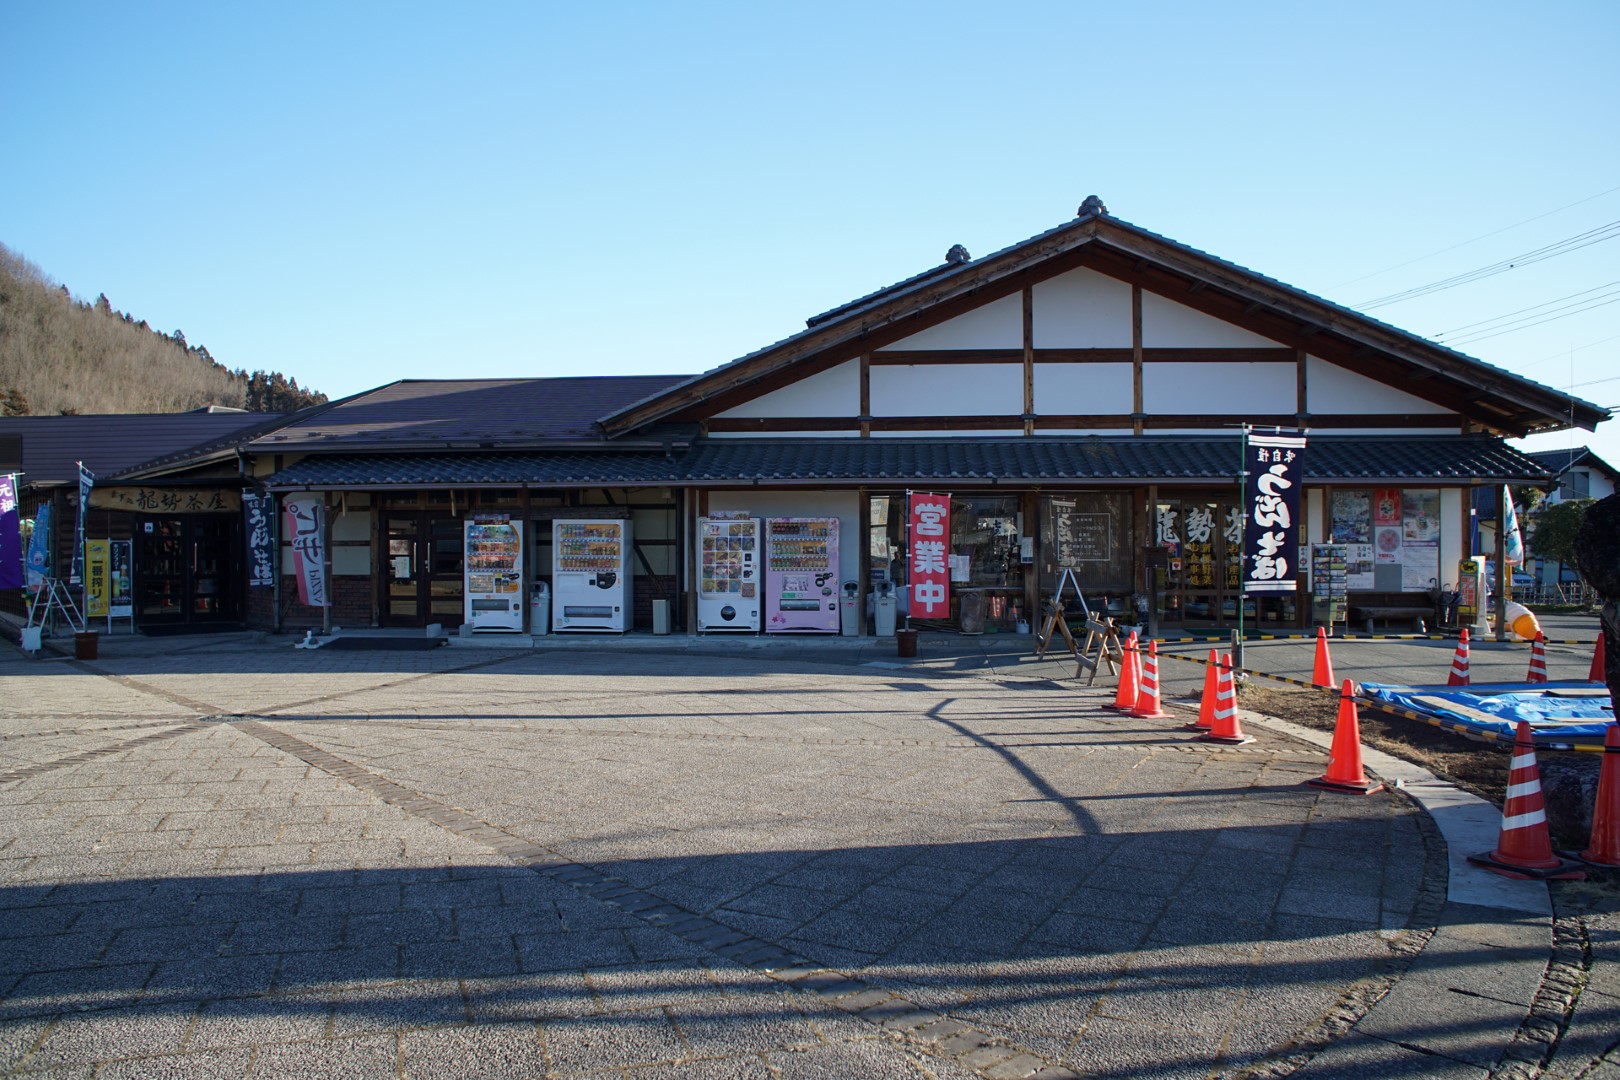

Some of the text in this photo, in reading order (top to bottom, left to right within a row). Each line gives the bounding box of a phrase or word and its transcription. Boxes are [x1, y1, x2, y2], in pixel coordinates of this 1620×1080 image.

[135, 488, 228, 511] 龍勢茶屋
[249, 508, 273, 579] うどんそば
[914, 502, 947, 613] 営業中
